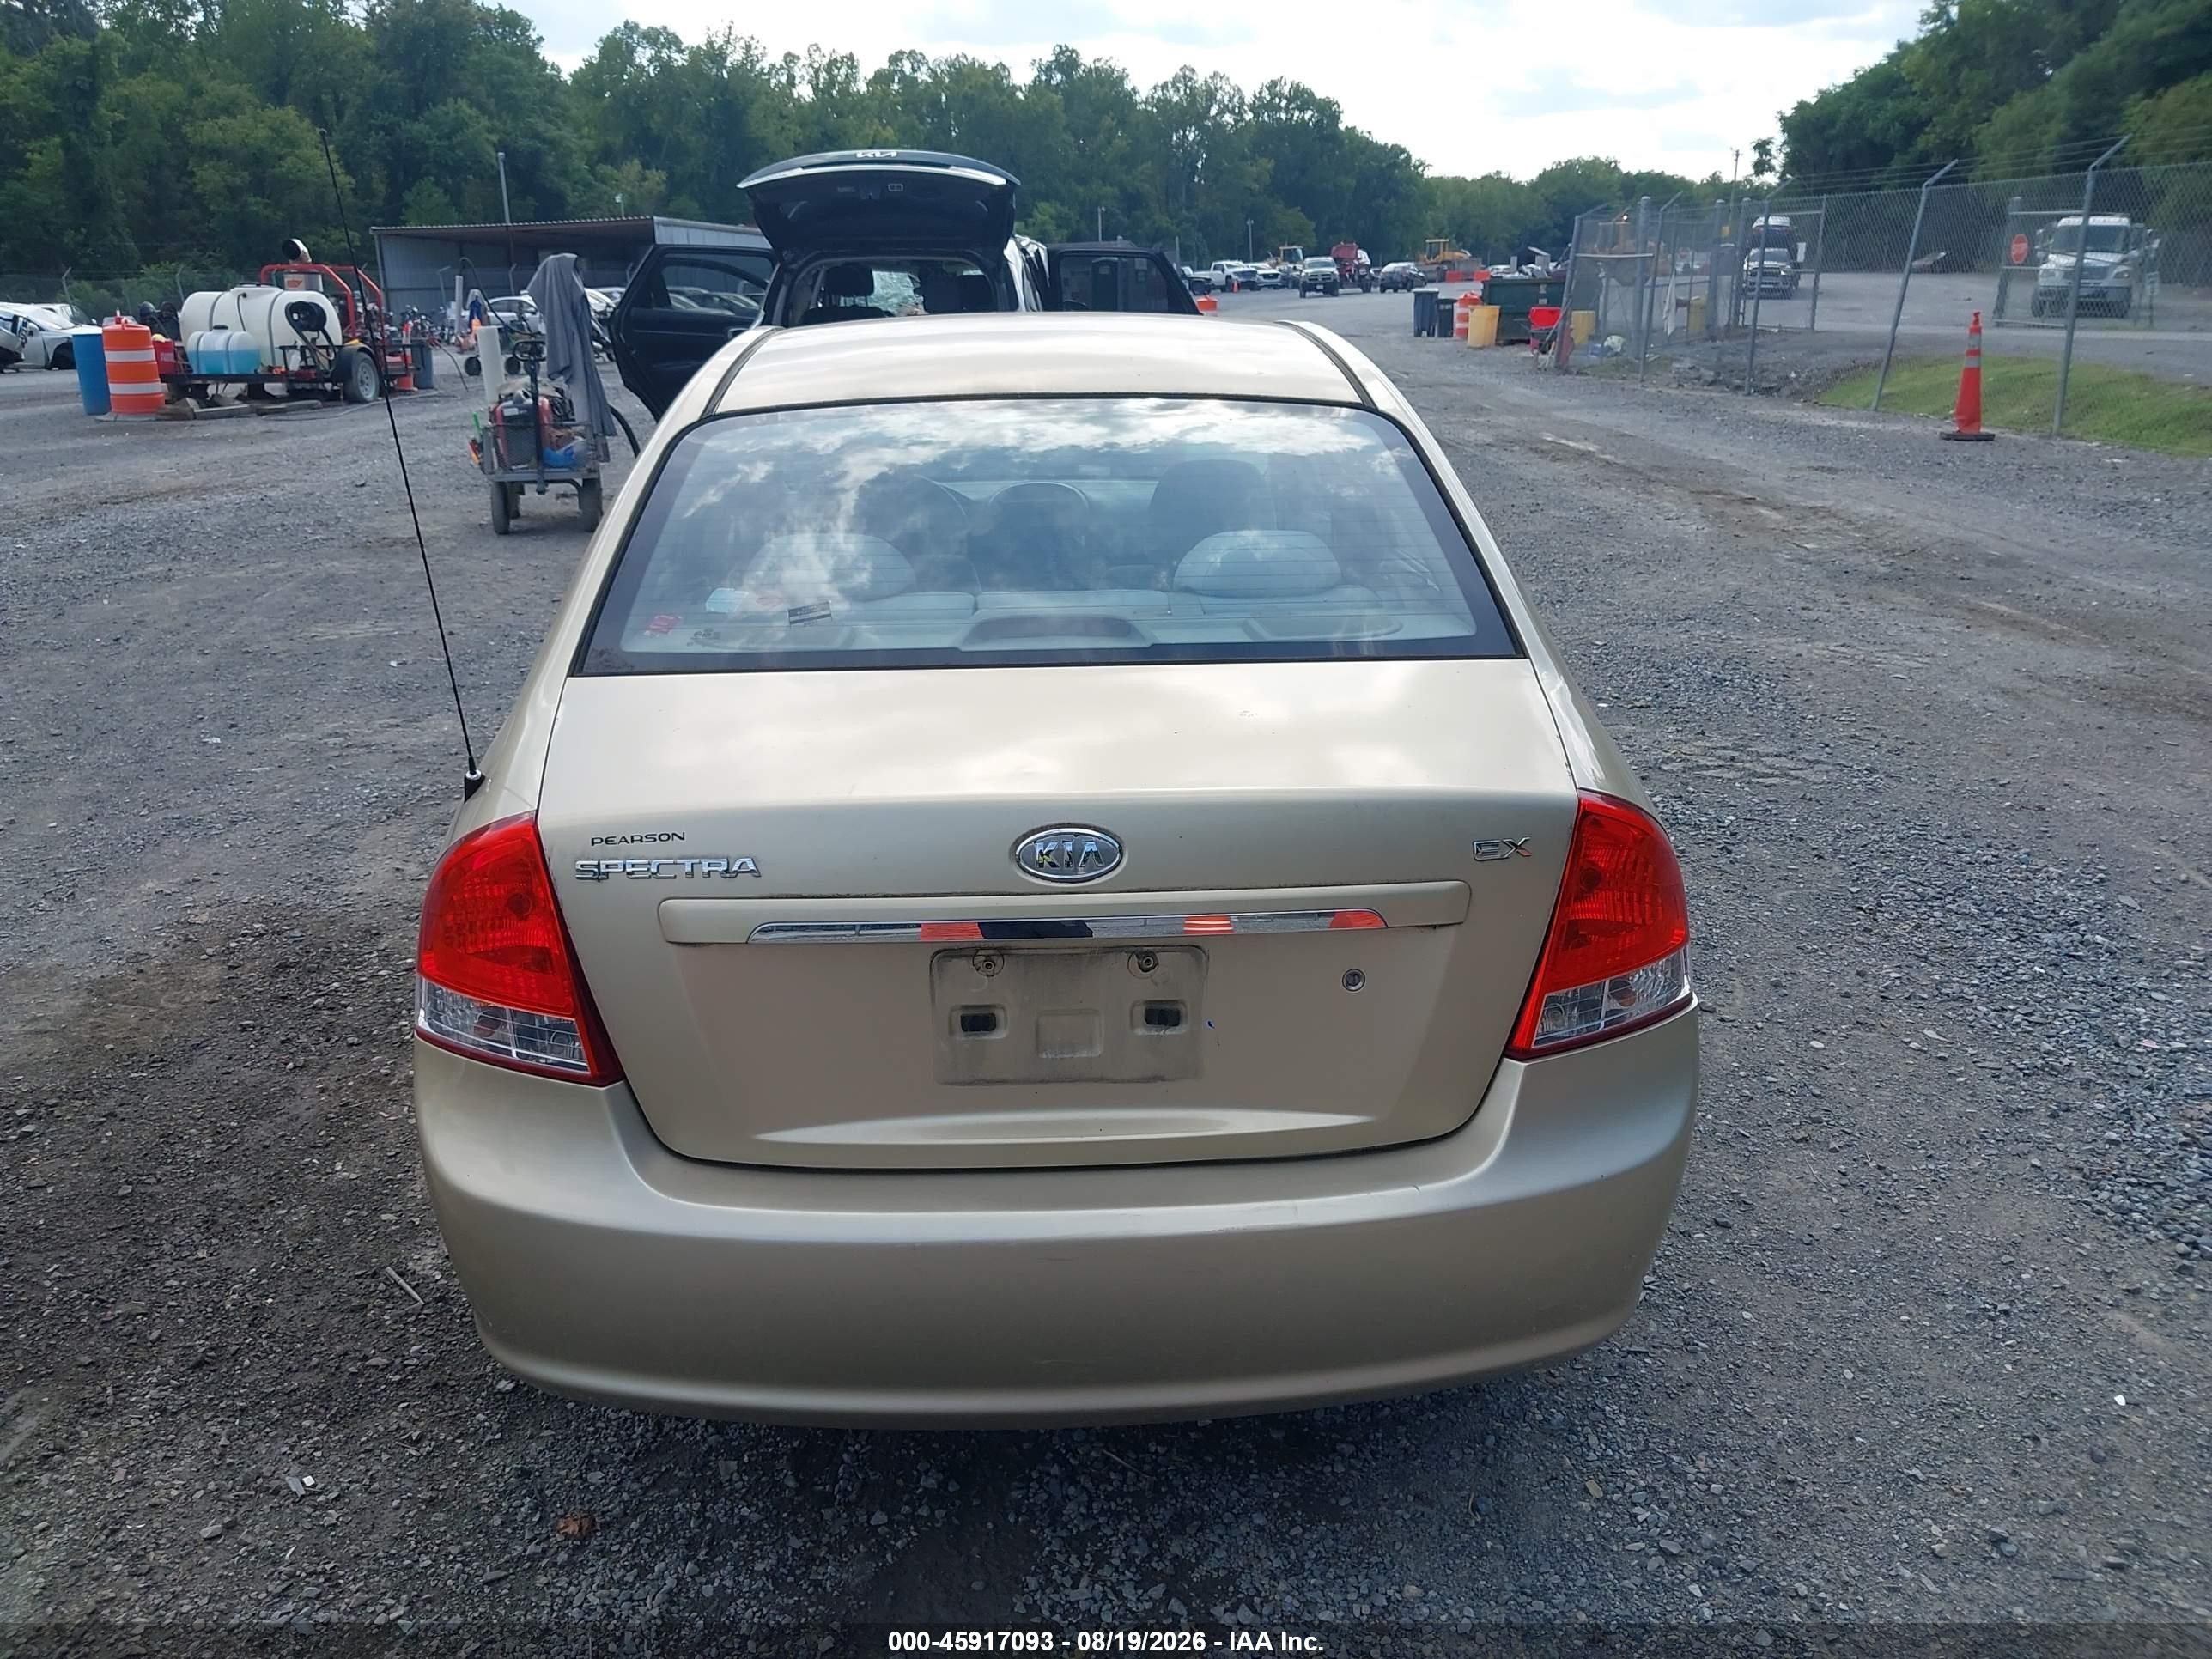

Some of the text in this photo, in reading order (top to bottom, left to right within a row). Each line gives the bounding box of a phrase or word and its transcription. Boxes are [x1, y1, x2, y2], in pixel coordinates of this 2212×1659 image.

[591, 831, 686, 847] PEARSON
[1472, 836, 1532, 861] EX
[1034, 840, 1105, 869] KIA
[574, 857, 762, 881] SPECTRA
